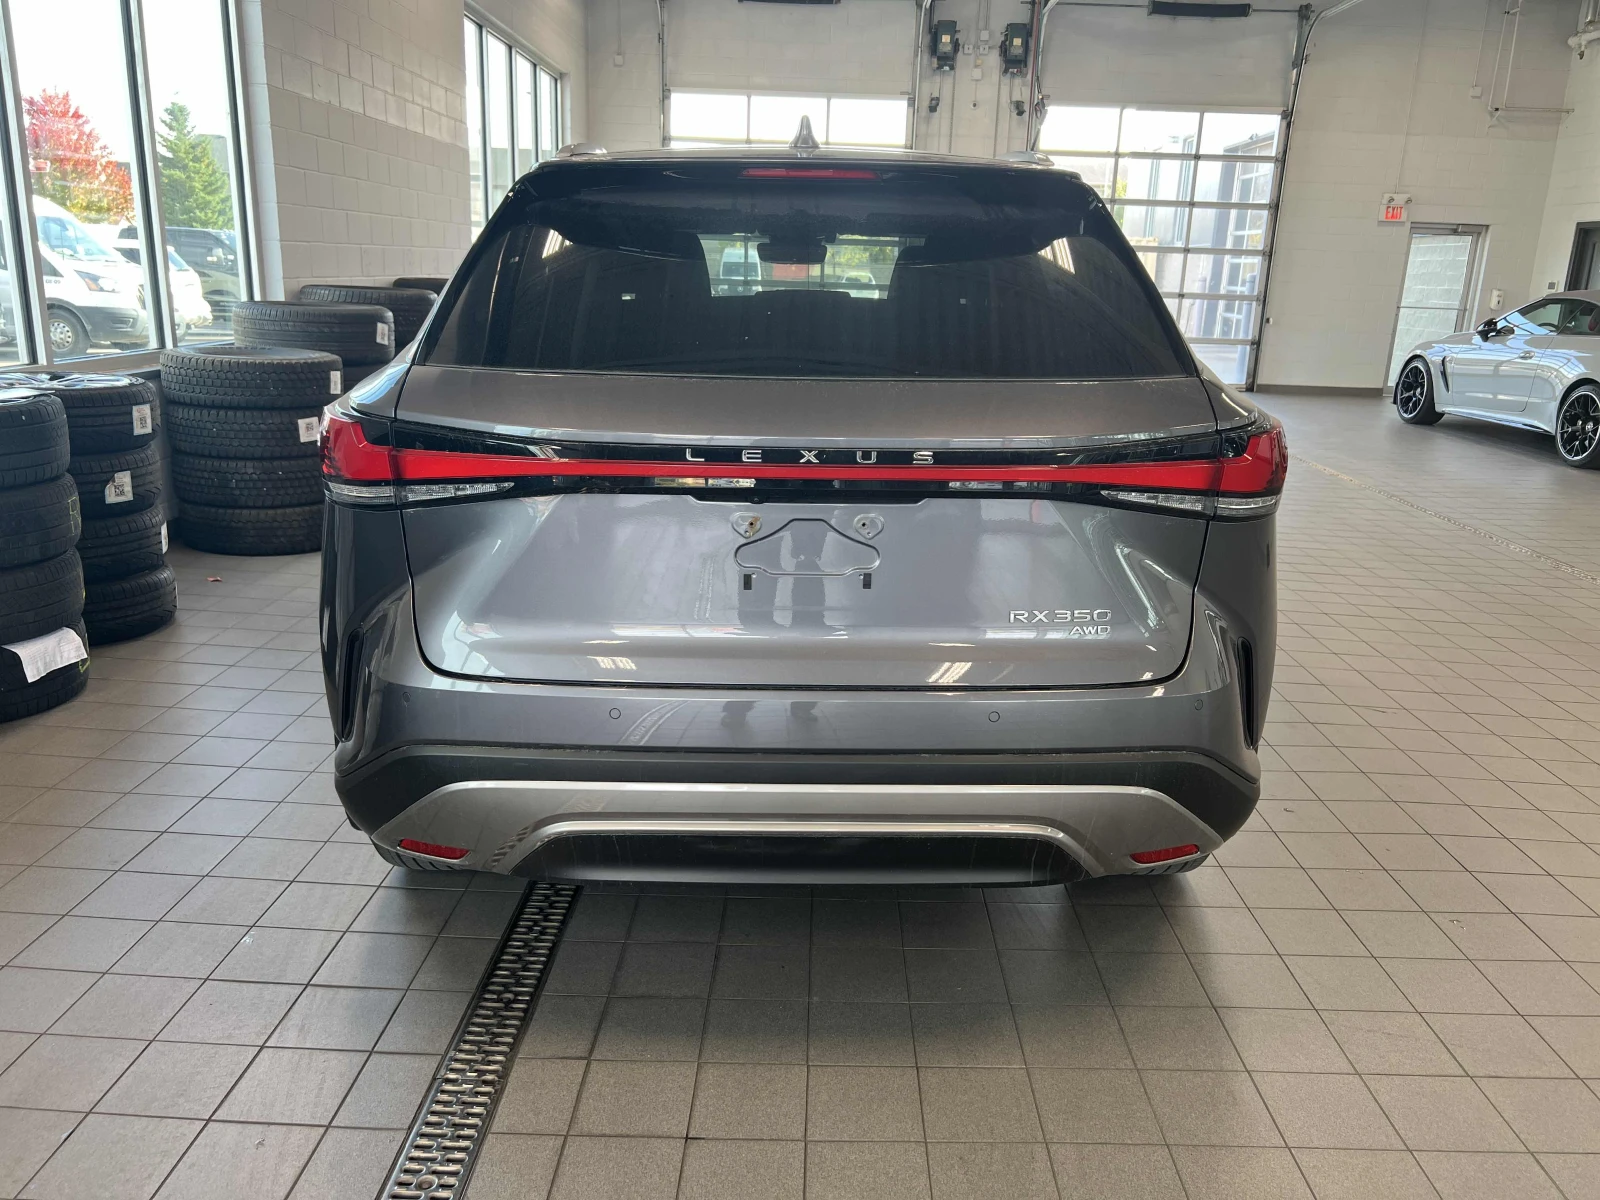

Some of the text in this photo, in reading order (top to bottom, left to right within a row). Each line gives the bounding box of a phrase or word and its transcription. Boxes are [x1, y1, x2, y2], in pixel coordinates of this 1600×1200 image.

[1384, 205, 1404, 220] EXIT
[686, 448, 934, 464] LEXUS
[1069, 625, 1111, 635] AWD
